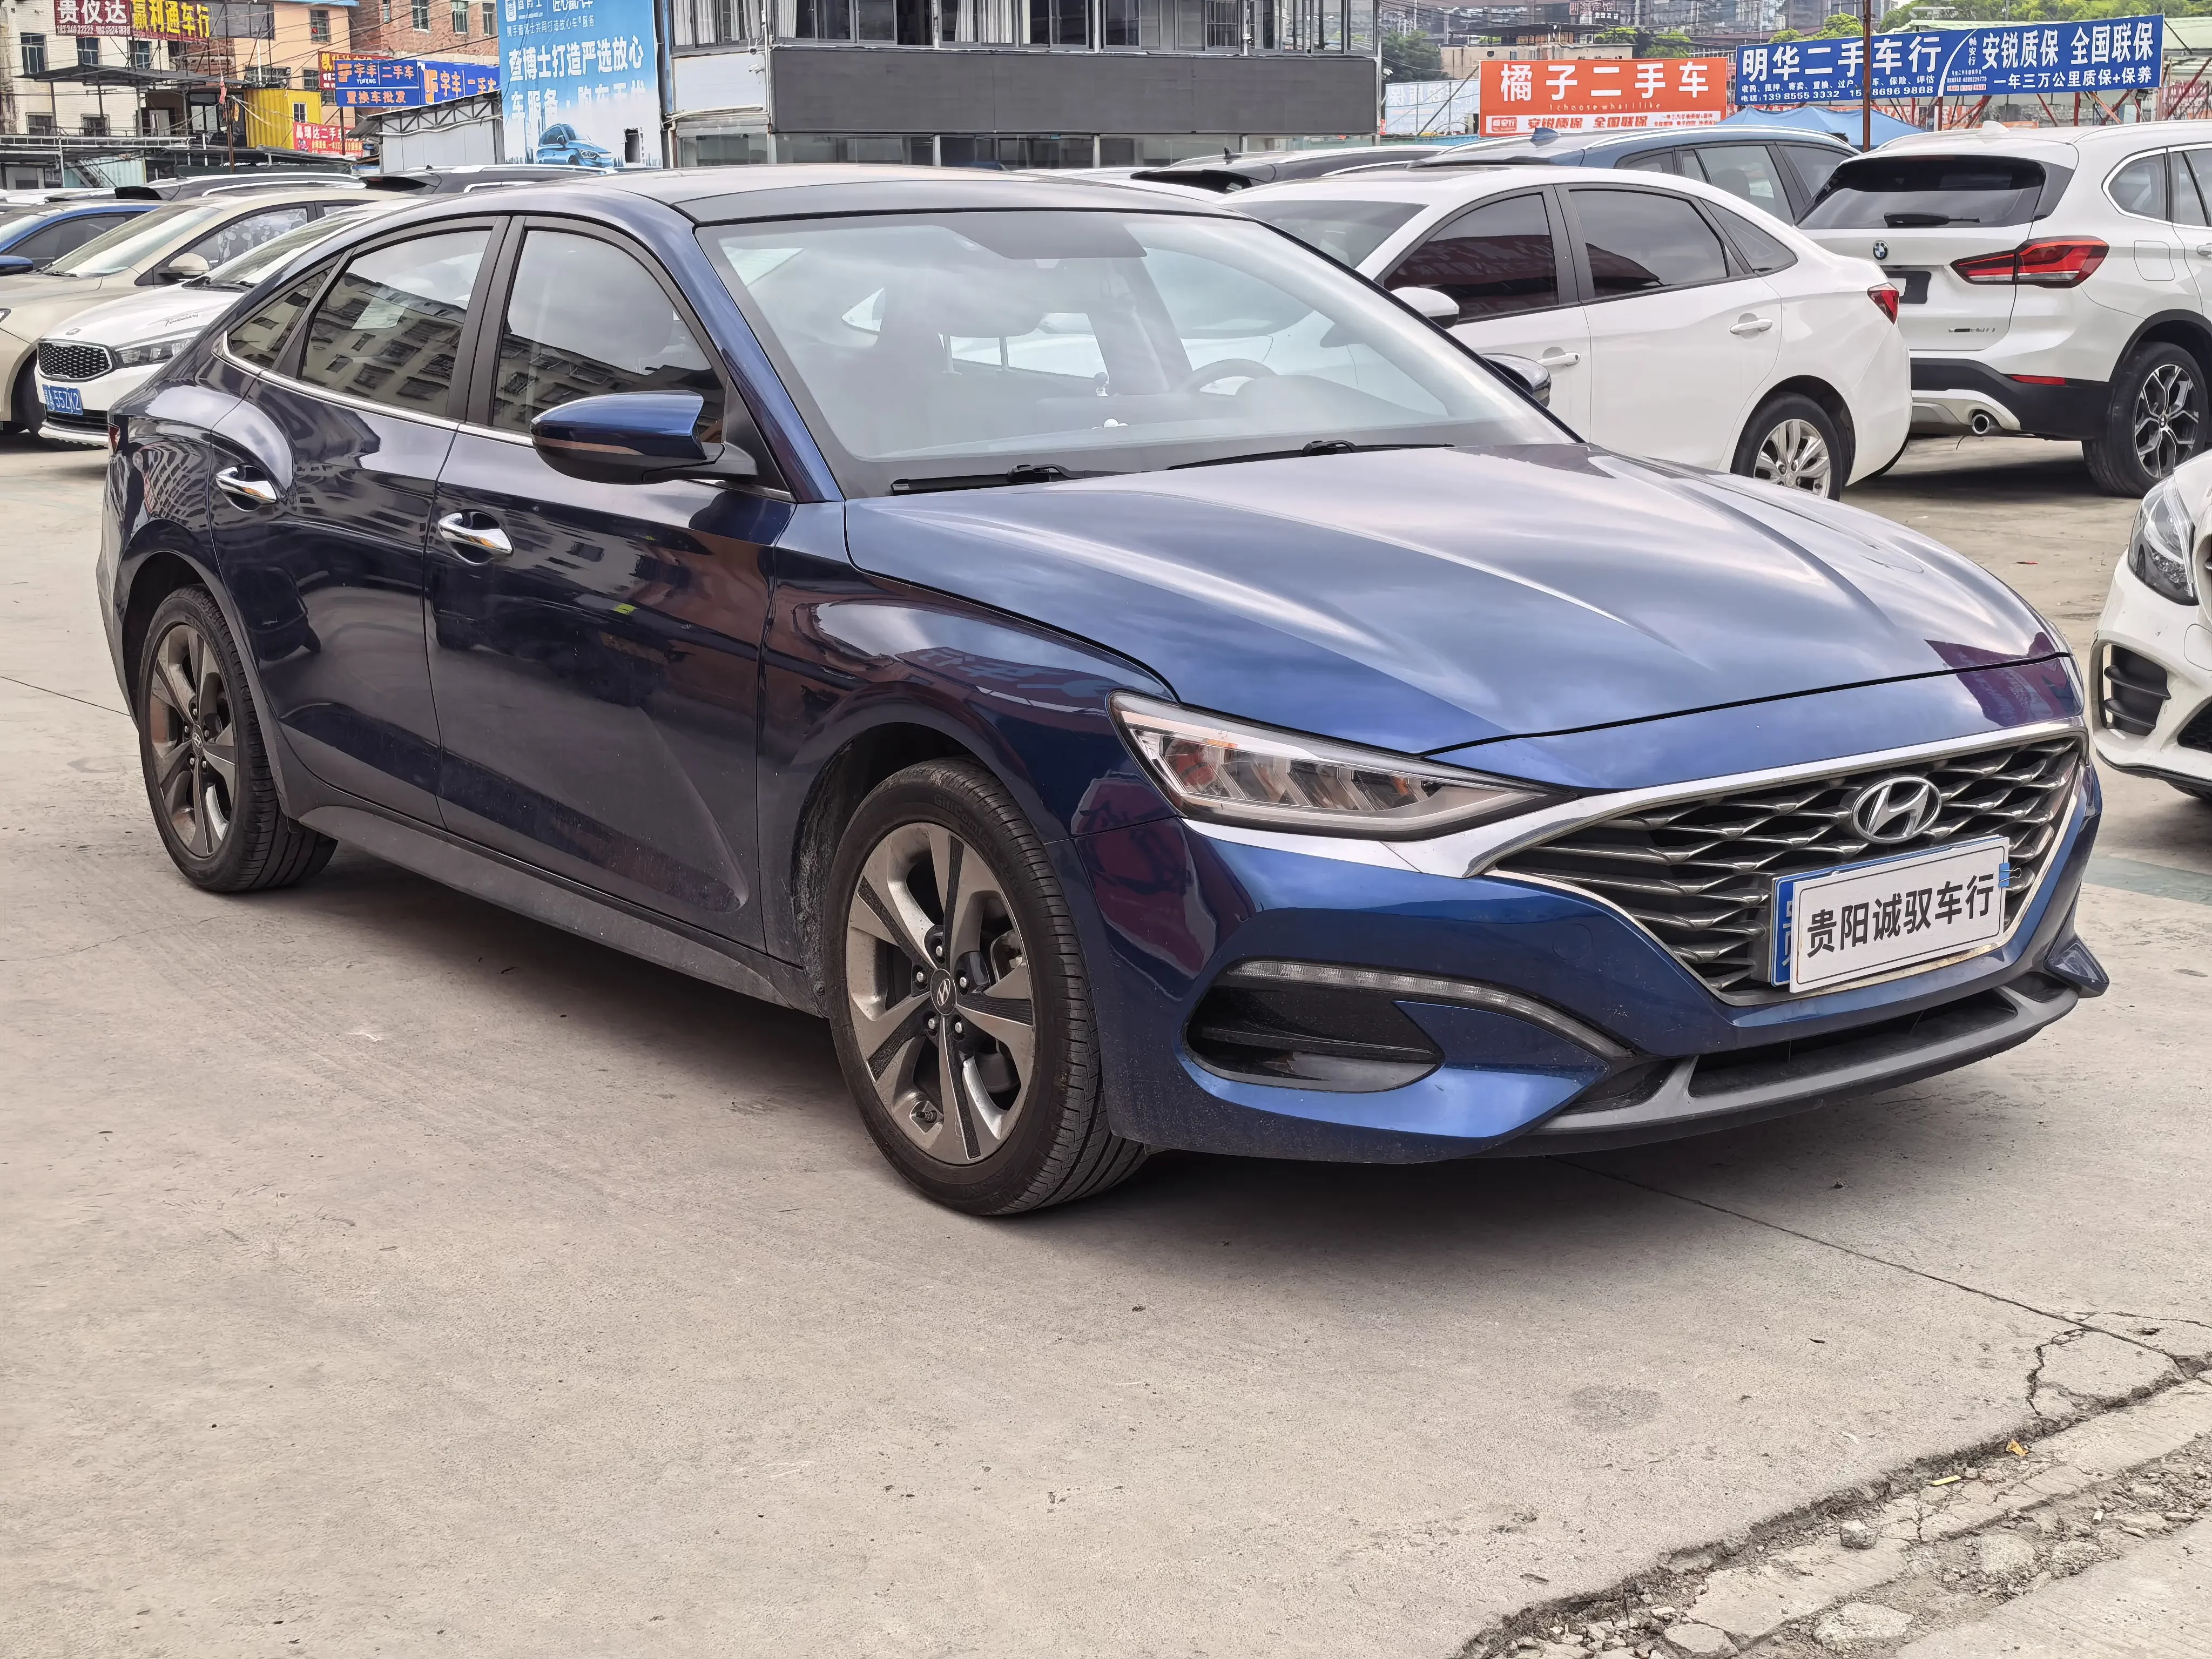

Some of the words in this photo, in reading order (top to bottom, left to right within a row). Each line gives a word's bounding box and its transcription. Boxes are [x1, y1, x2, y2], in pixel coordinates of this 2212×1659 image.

[508, 35, 644, 82] 查博士打造严选放心
[1742, 35, 1941, 82] 明华二手车行
[1981, 29, 2059, 70] 安锐质保
[2071, 22, 2154, 64] 全国联保
[382, 65, 414, 79] 二手车
[1500, 61, 1709, 102] 橘子二手车
[1993, 65, 2153, 89] 一年三万公里质保+保养
[1784, 92, 1810, 100] 8555
[1813, 90, 1839, 98] 3332
[1806, 873, 1994, 959] 贵阳诚驭车行
